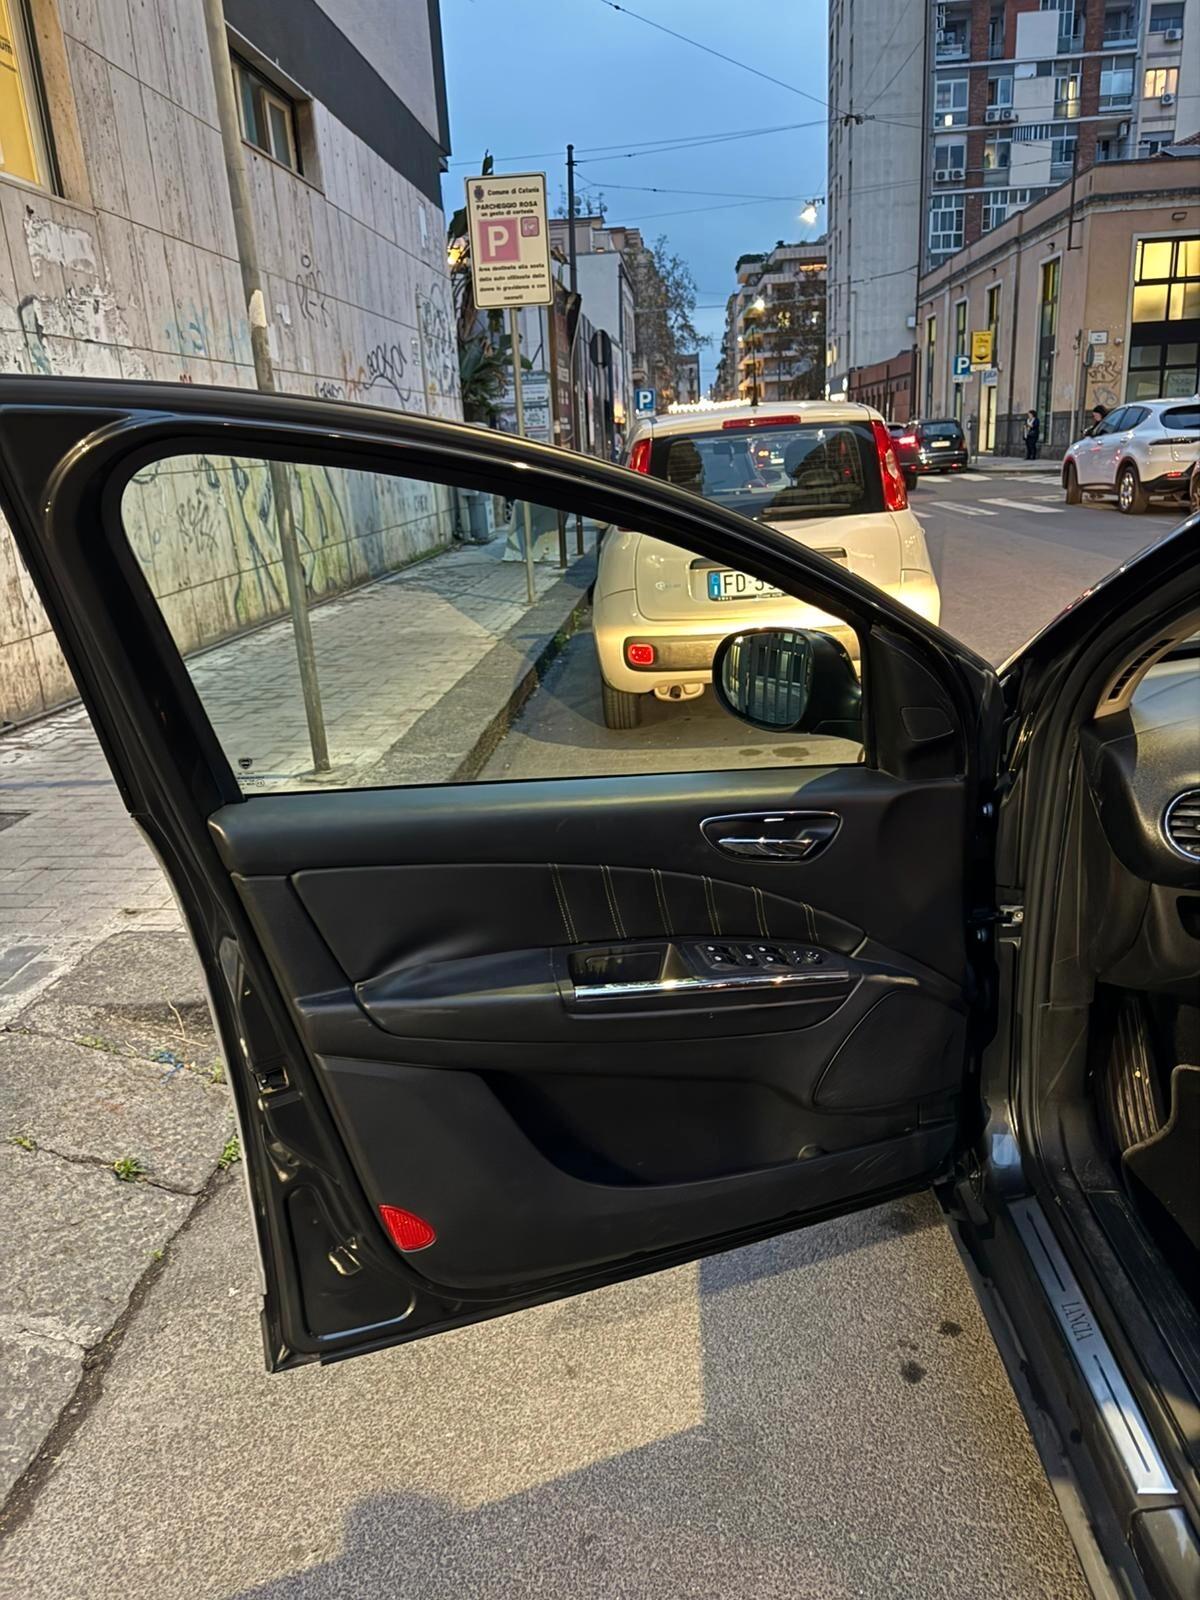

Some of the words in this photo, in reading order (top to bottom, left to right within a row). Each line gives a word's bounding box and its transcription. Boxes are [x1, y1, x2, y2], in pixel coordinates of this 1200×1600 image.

[476, 202, 517, 210] PARCHEGGIO
[488, 226, 509, 257] P
[957, 356, 970, 374] P
[639, 391, 652, 410] P
[1061, 1301, 1094, 1342] LANCIA
